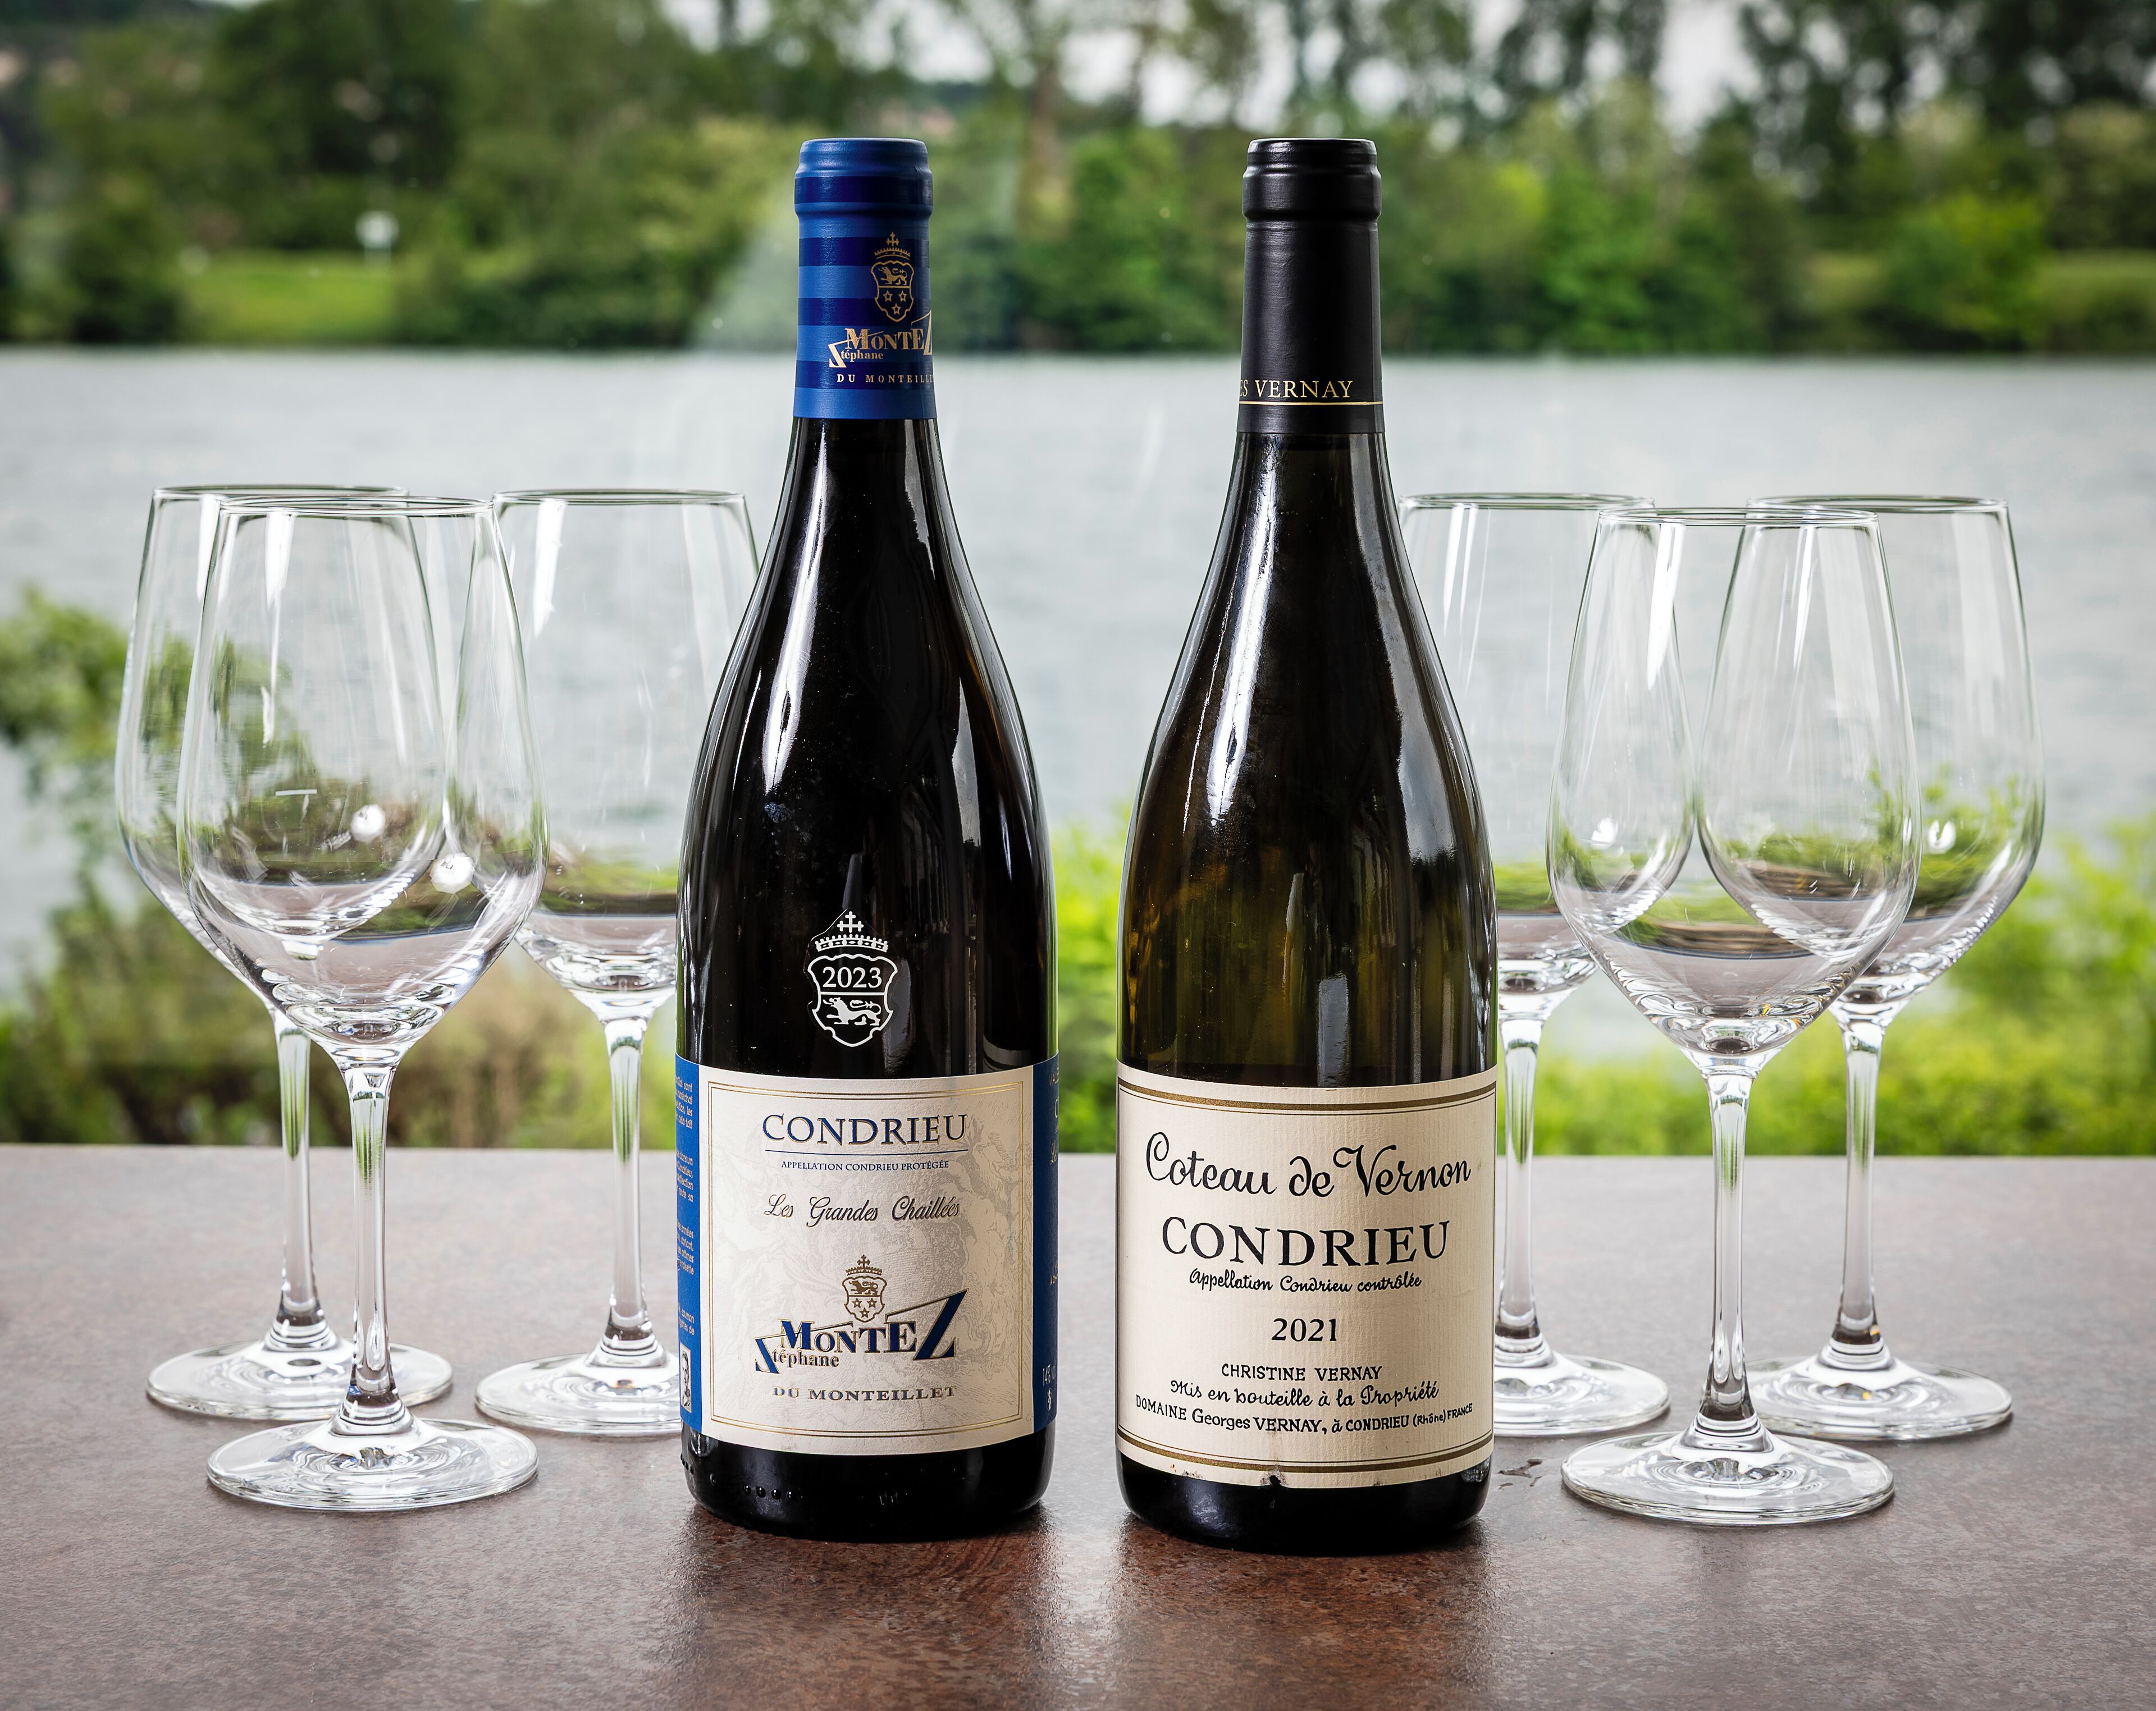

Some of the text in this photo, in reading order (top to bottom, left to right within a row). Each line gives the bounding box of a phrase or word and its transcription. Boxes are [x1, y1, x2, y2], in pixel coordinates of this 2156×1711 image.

[828, 331, 884, 368] Stéphane
[837, 374, 856, 382] DU
[1255, 379, 1353, 398] VERNAY
[822, 966, 882, 988] 2023
[762, 1113, 968, 1146] CONDRIEU
[781, 1160, 949, 1172] APPELLATION CONDRIEU PROTÉGÉE
[1145, 1132, 1472, 1197] Coteau de Vernon
[764, 1193, 961, 1227] Les Grandes Chaillées
[1162, 1216, 1450, 1266] CONDRIEU
[1189, 1268, 1422, 1292] Appellation Condrieu contrôlée
[1271, 1317, 1337, 1342] 2021
[754, 1321, 854, 1374] Stéphane
[1221, 1363, 1383, 1381] CHRISTINE VERNAY
[772, 1386, 957, 1401] DU MONTEILLET
[1171, 1380, 1440, 1407] Mis en bouteille à la Propriété
[1136, 1394, 1473, 1435] DOMAINE Georges VERNAY, à CONDRIEU (Rhône) FRANCE
